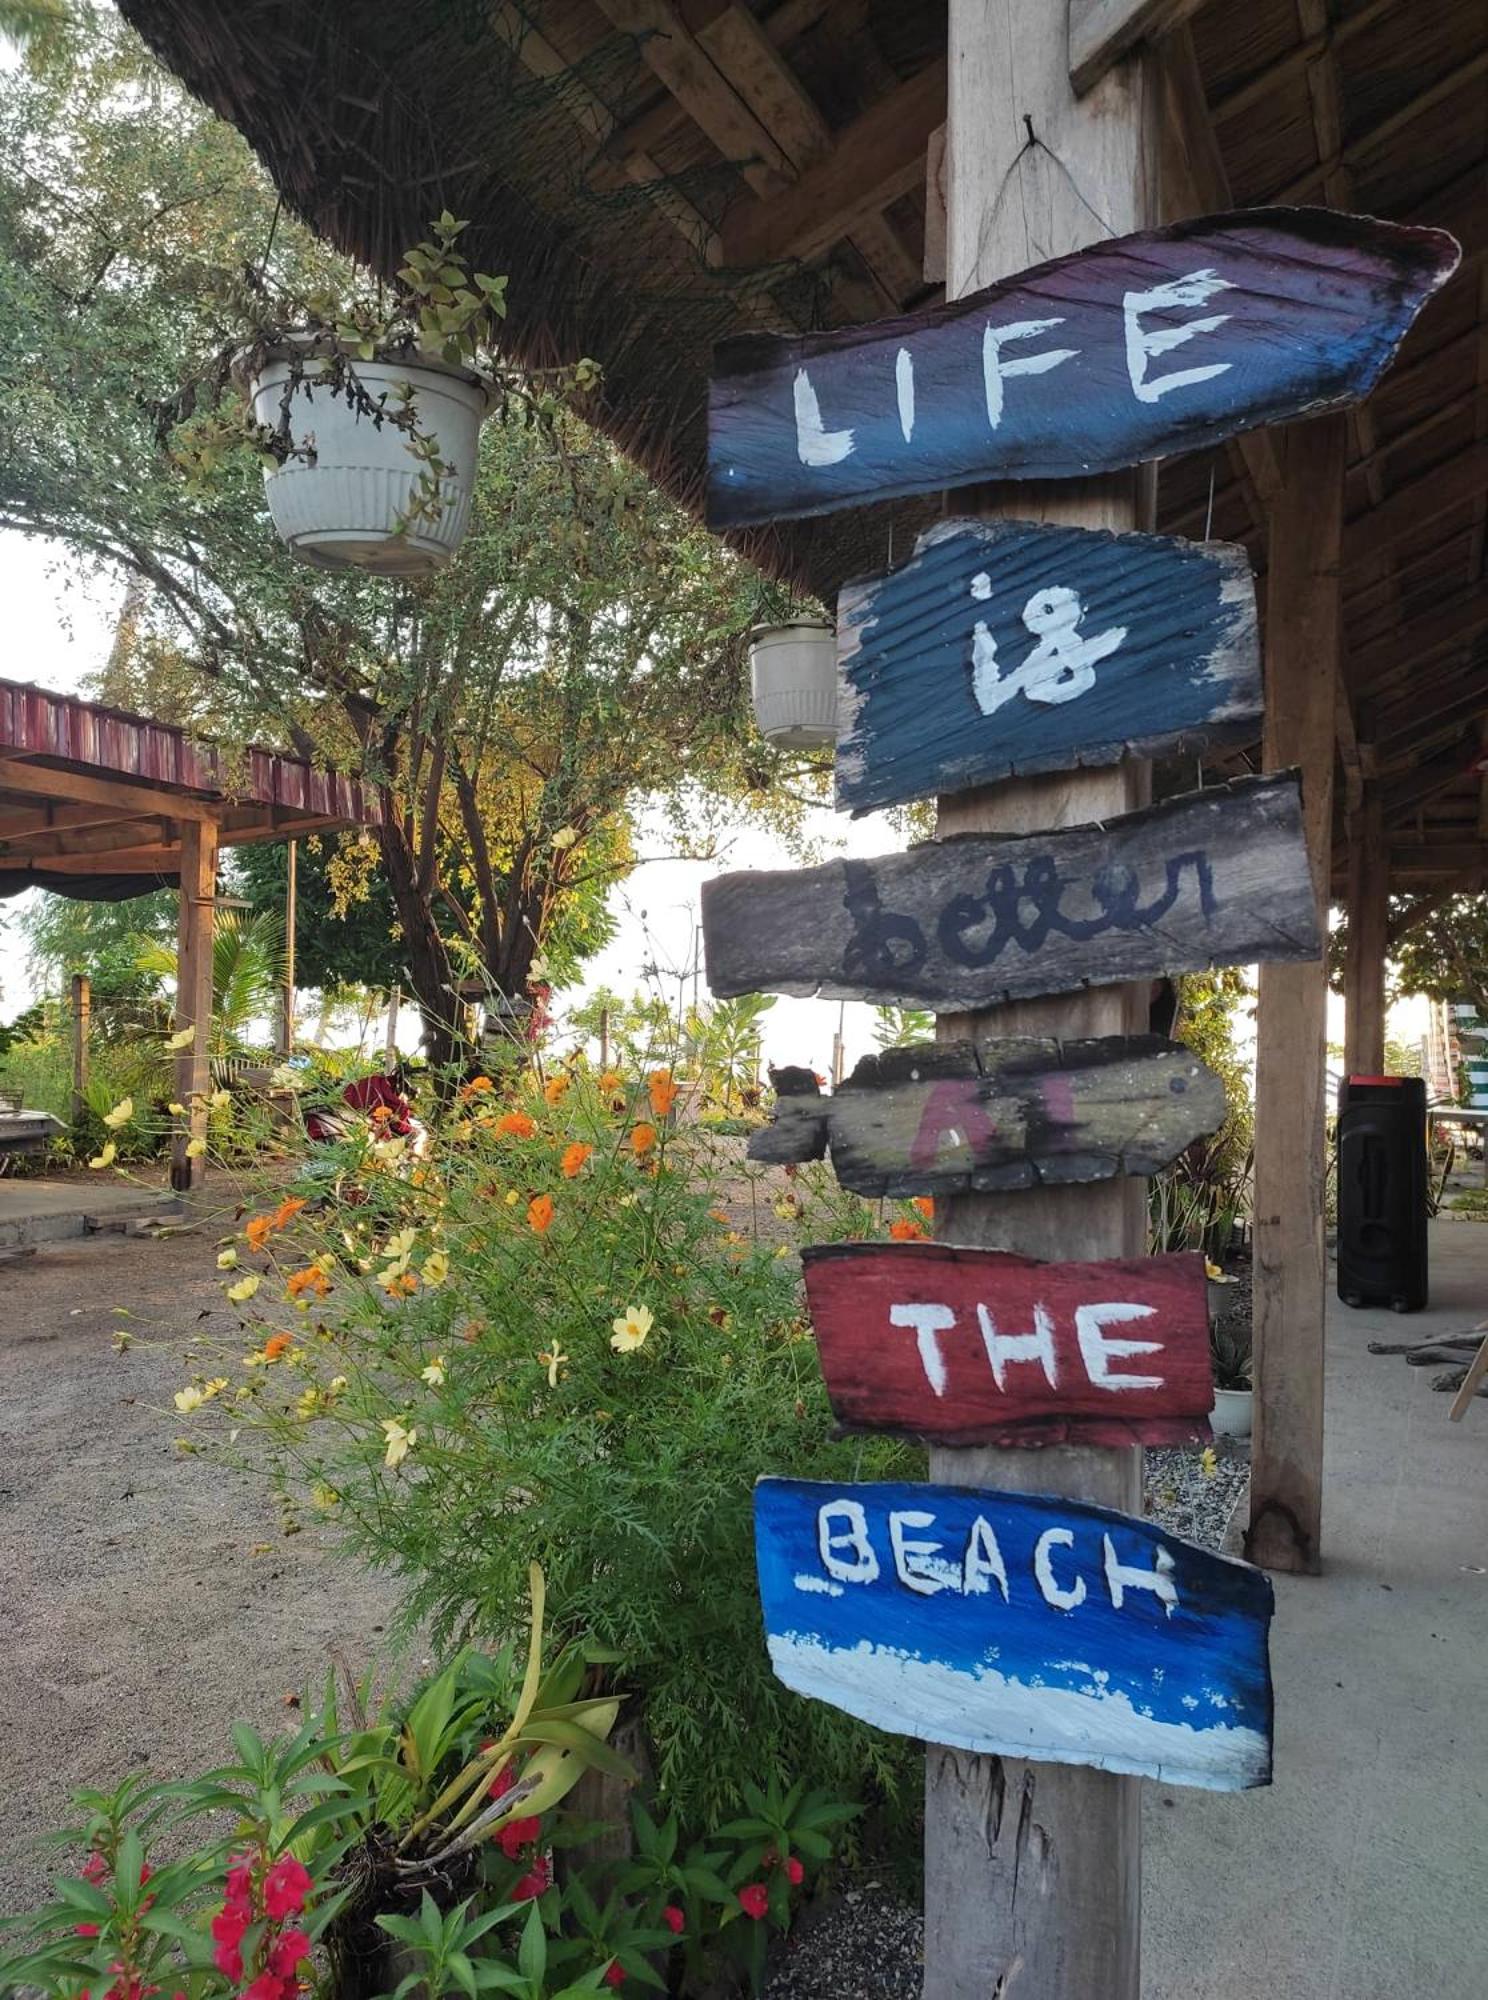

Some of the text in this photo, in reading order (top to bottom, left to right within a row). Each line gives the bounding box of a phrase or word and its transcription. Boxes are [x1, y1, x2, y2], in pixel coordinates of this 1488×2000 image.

[793, 268, 1240, 468] LIFE
[843, 852, 1217, 974] better
[888, 1301, 1165, 1397] THE
[816, 1498, 1178, 1621] BEACH
